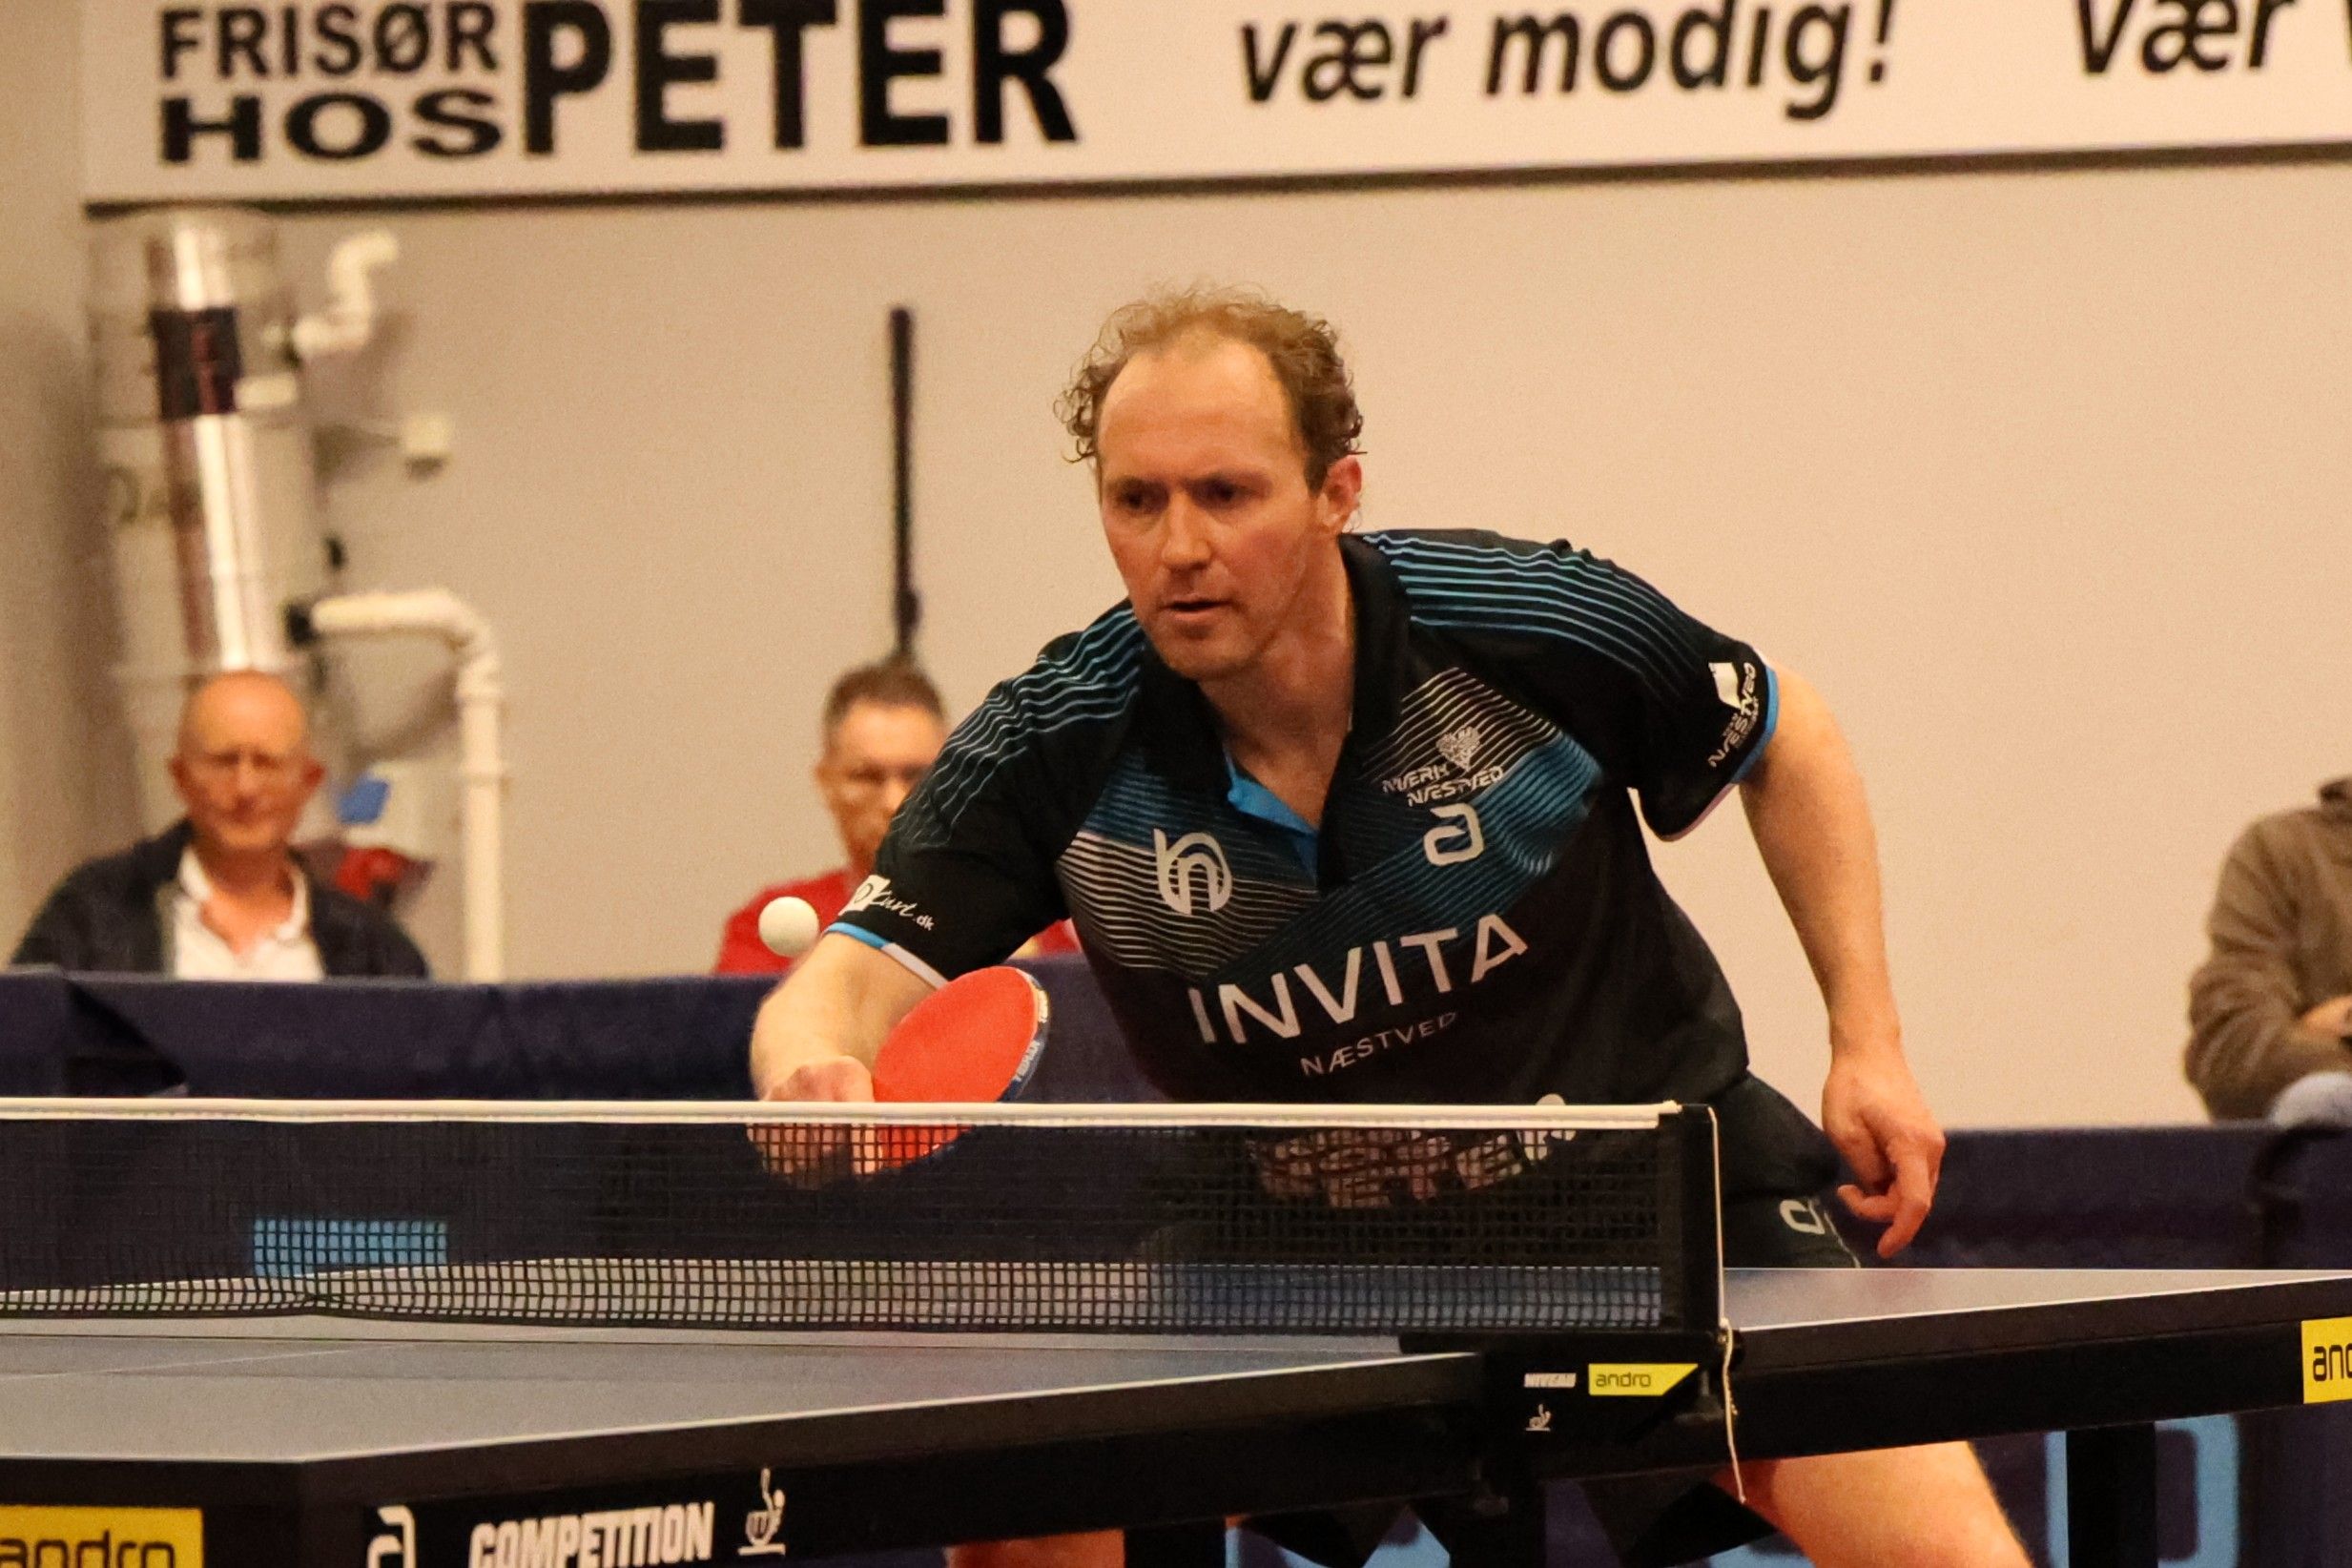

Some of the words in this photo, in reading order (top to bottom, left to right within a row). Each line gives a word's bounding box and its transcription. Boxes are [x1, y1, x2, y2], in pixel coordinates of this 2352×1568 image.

[161, 4, 499, 78] FRISØR
[524, 0, 1078, 155] PETER
[1240, 17, 1450, 102] vær
[1485, 0, 1895, 120] modig!
[162, 90, 503, 163] HOS
[1187, 913, 1528, 1044] INVITA
[1300, 1011, 1456, 1077] NÆSTVED
[1595, 1372, 1651, 1388] andro
[468, 1501, 714, 1568] COMPETITION
